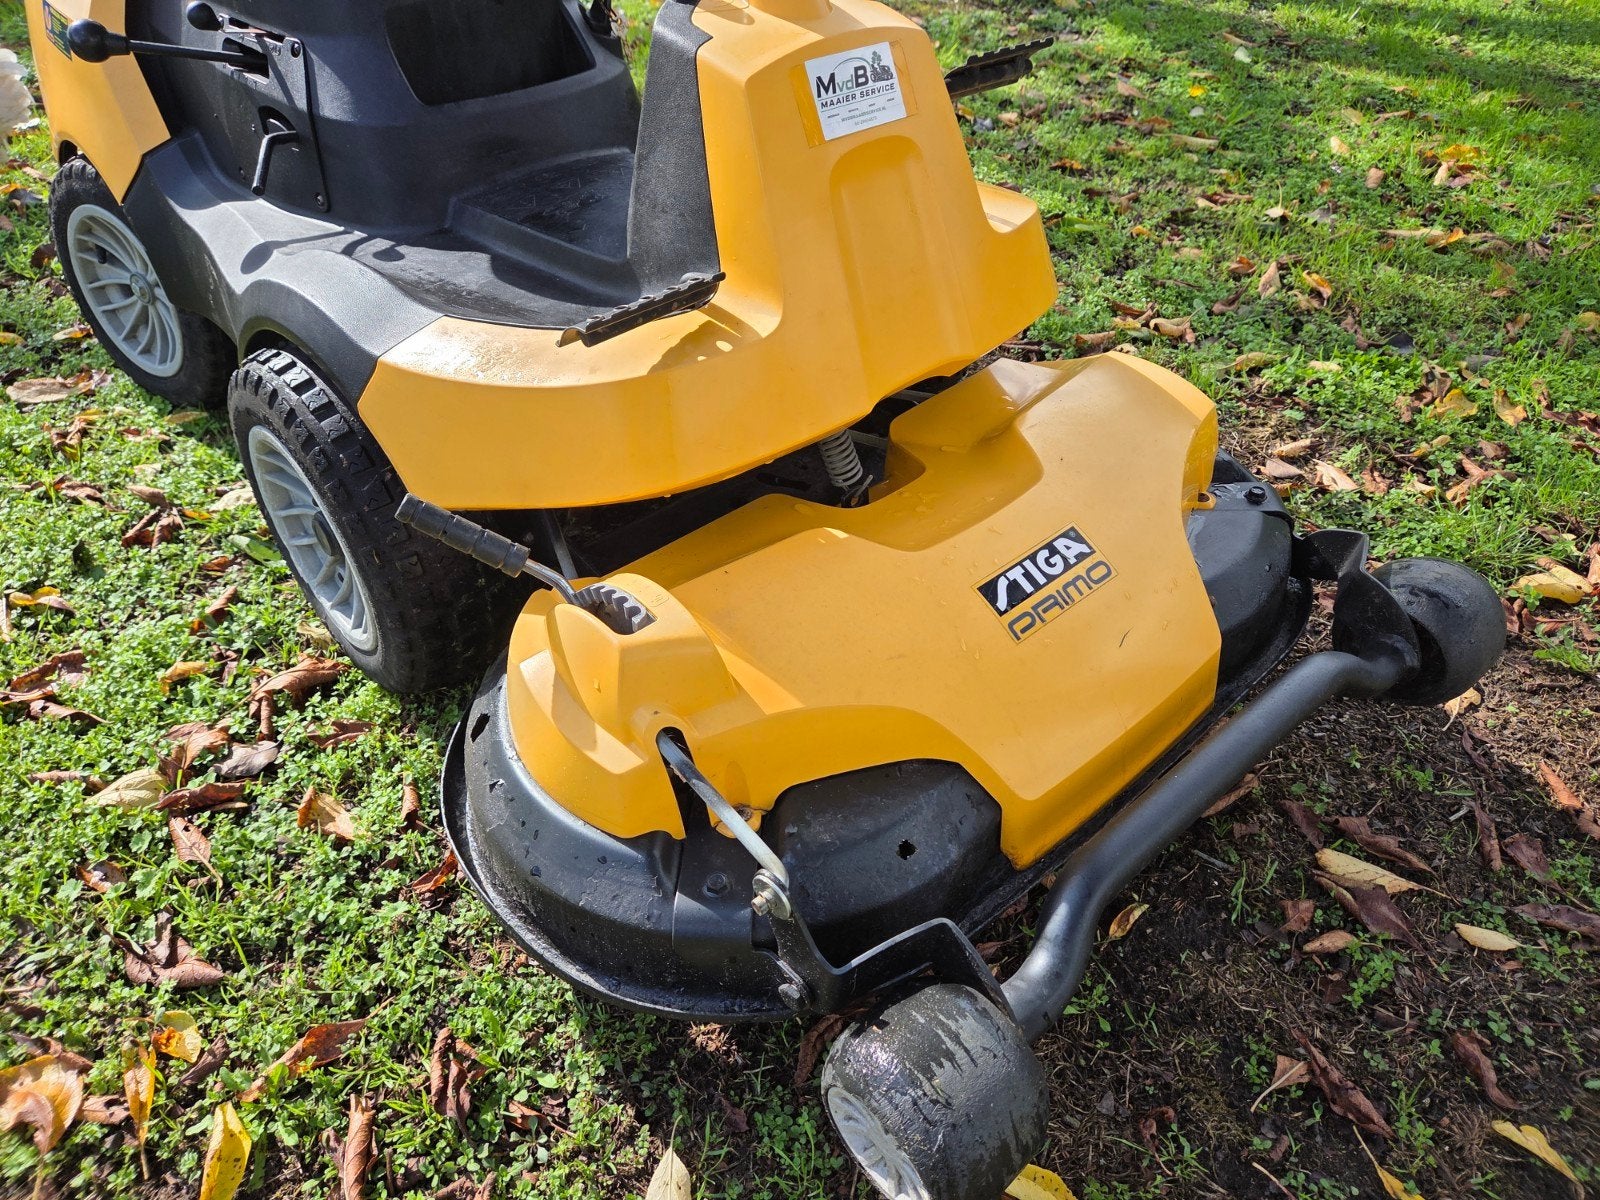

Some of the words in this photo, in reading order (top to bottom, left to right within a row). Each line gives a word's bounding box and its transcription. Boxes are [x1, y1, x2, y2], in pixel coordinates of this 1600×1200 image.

[815, 64, 870, 99] MvdB
[820, 93, 858, 110] MAAIER
[859, 82, 896, 99] SERVICE
[995, 536, 1092, 612] STIGA
[1007, 560, 1113, 641] PRIMO
